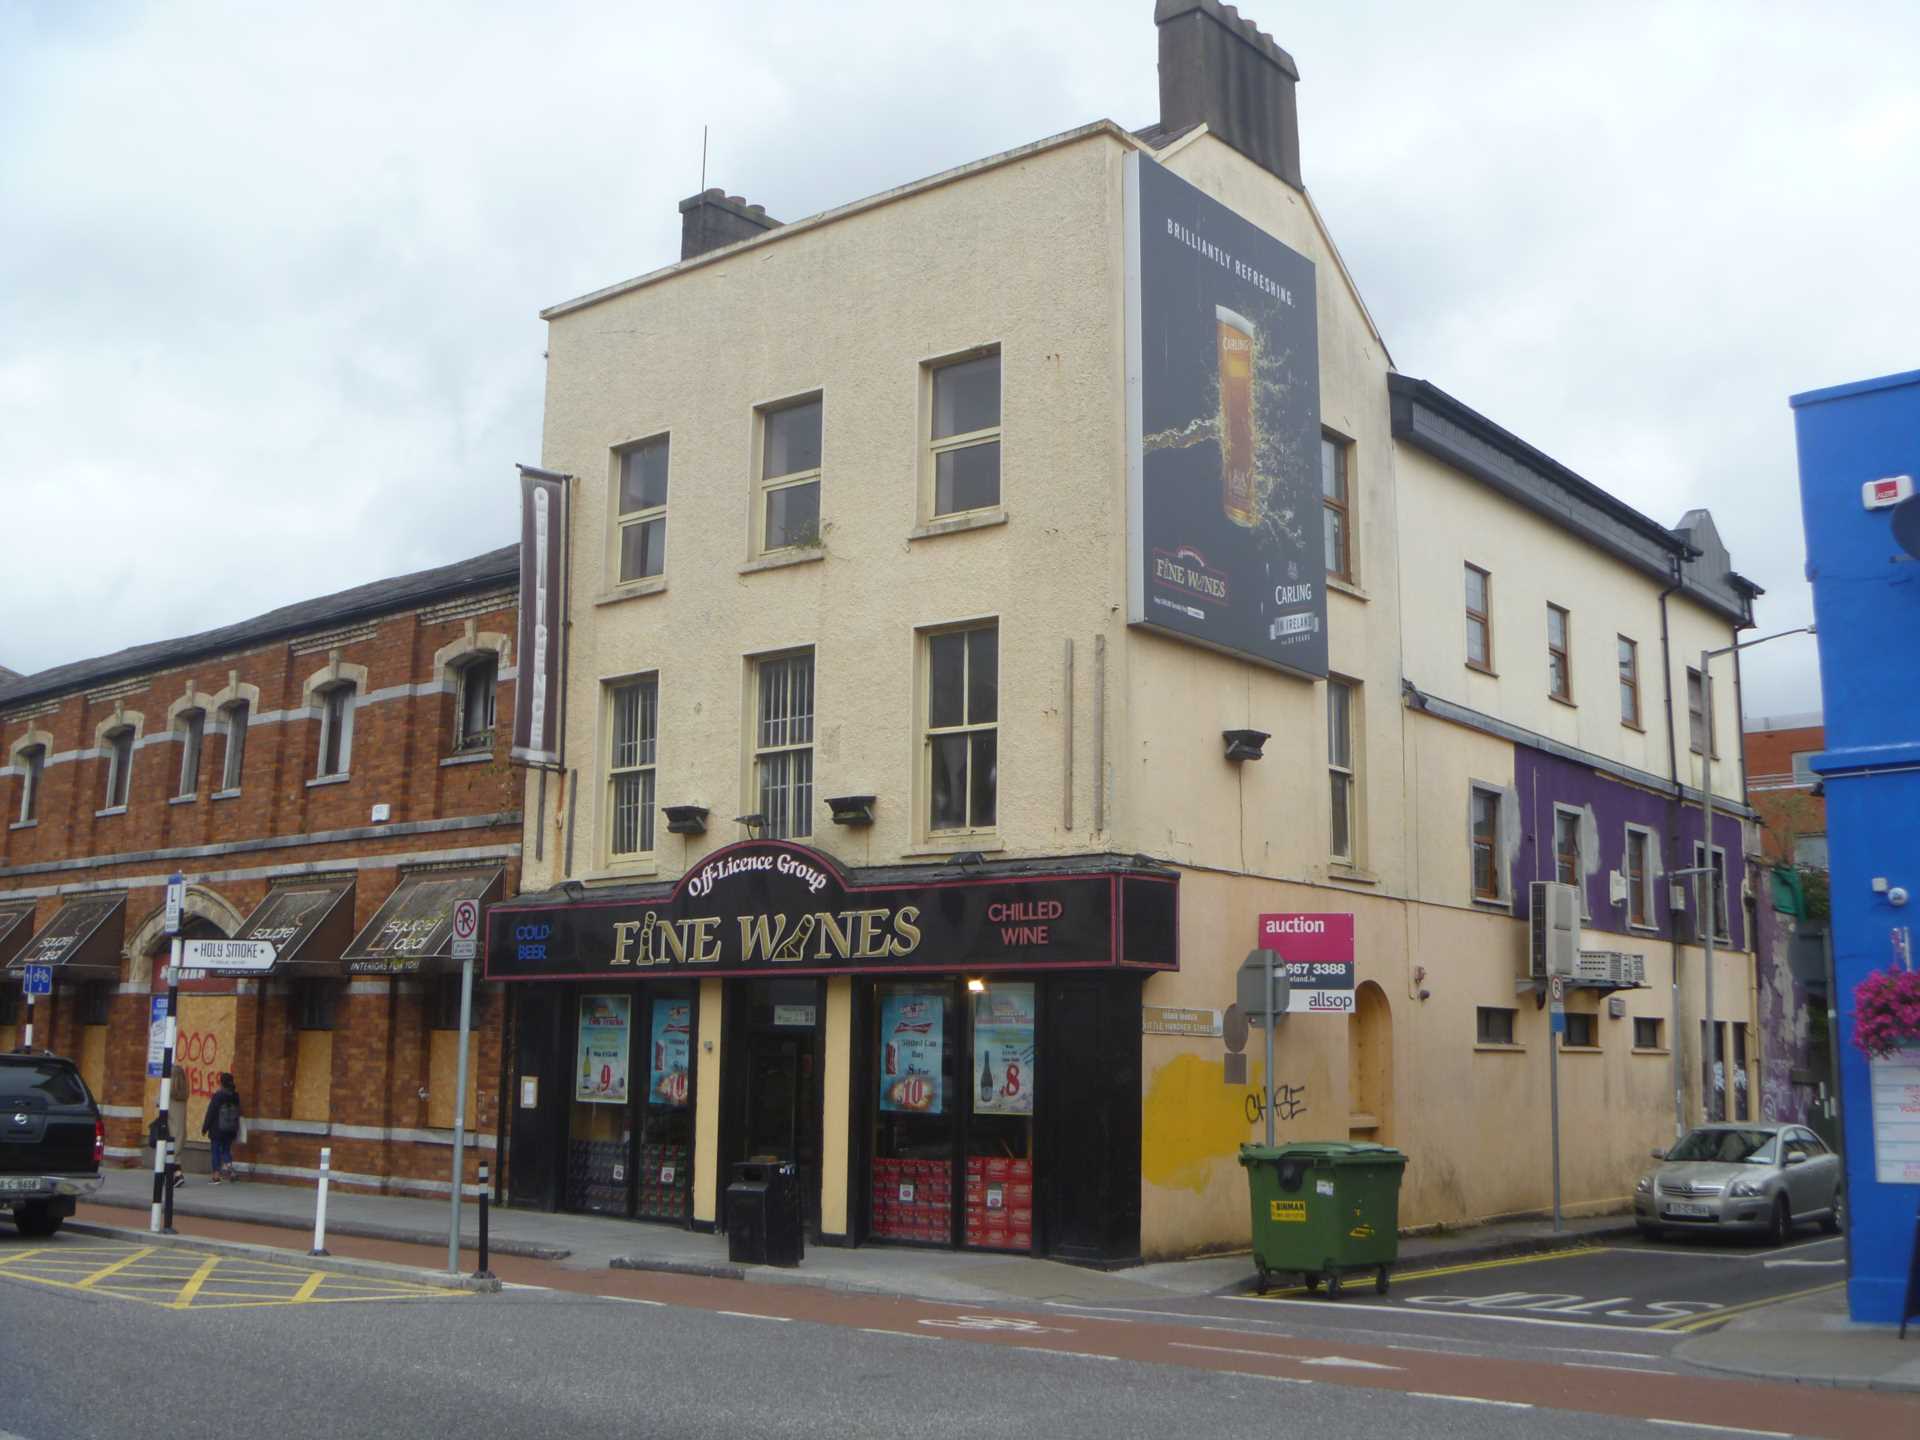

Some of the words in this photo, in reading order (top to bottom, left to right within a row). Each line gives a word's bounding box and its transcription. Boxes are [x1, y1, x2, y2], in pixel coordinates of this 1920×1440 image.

[1167, 218, 1231, 269] BRILLIANTLY
[1156, 557, 1185, 585] FINE
[1187, 569, 1226, 598] WINES
[1275, 583, 1312, 605] CARLING
[688, 854, 774, 898] Off-Licence
[776, 853, 828, 894] Group
[987, 901, 1063, 922] CHILLED
[515, 924, 550, 941] COLD
[1265, 915, 1325, 933] auction
[610, 911, 722, 966] FINE
[737, 905, 922, 962] WINES
[1001, 925, 1049, 945] WINE
[200, 942, 224, 958] HOLY
[226, 943, 259, 959] SMOKE
[517, 943, 547, 961] BEER
[1312, 963, 1346, 975] 3388
[1308, 991, 1353, 1010] allsop
